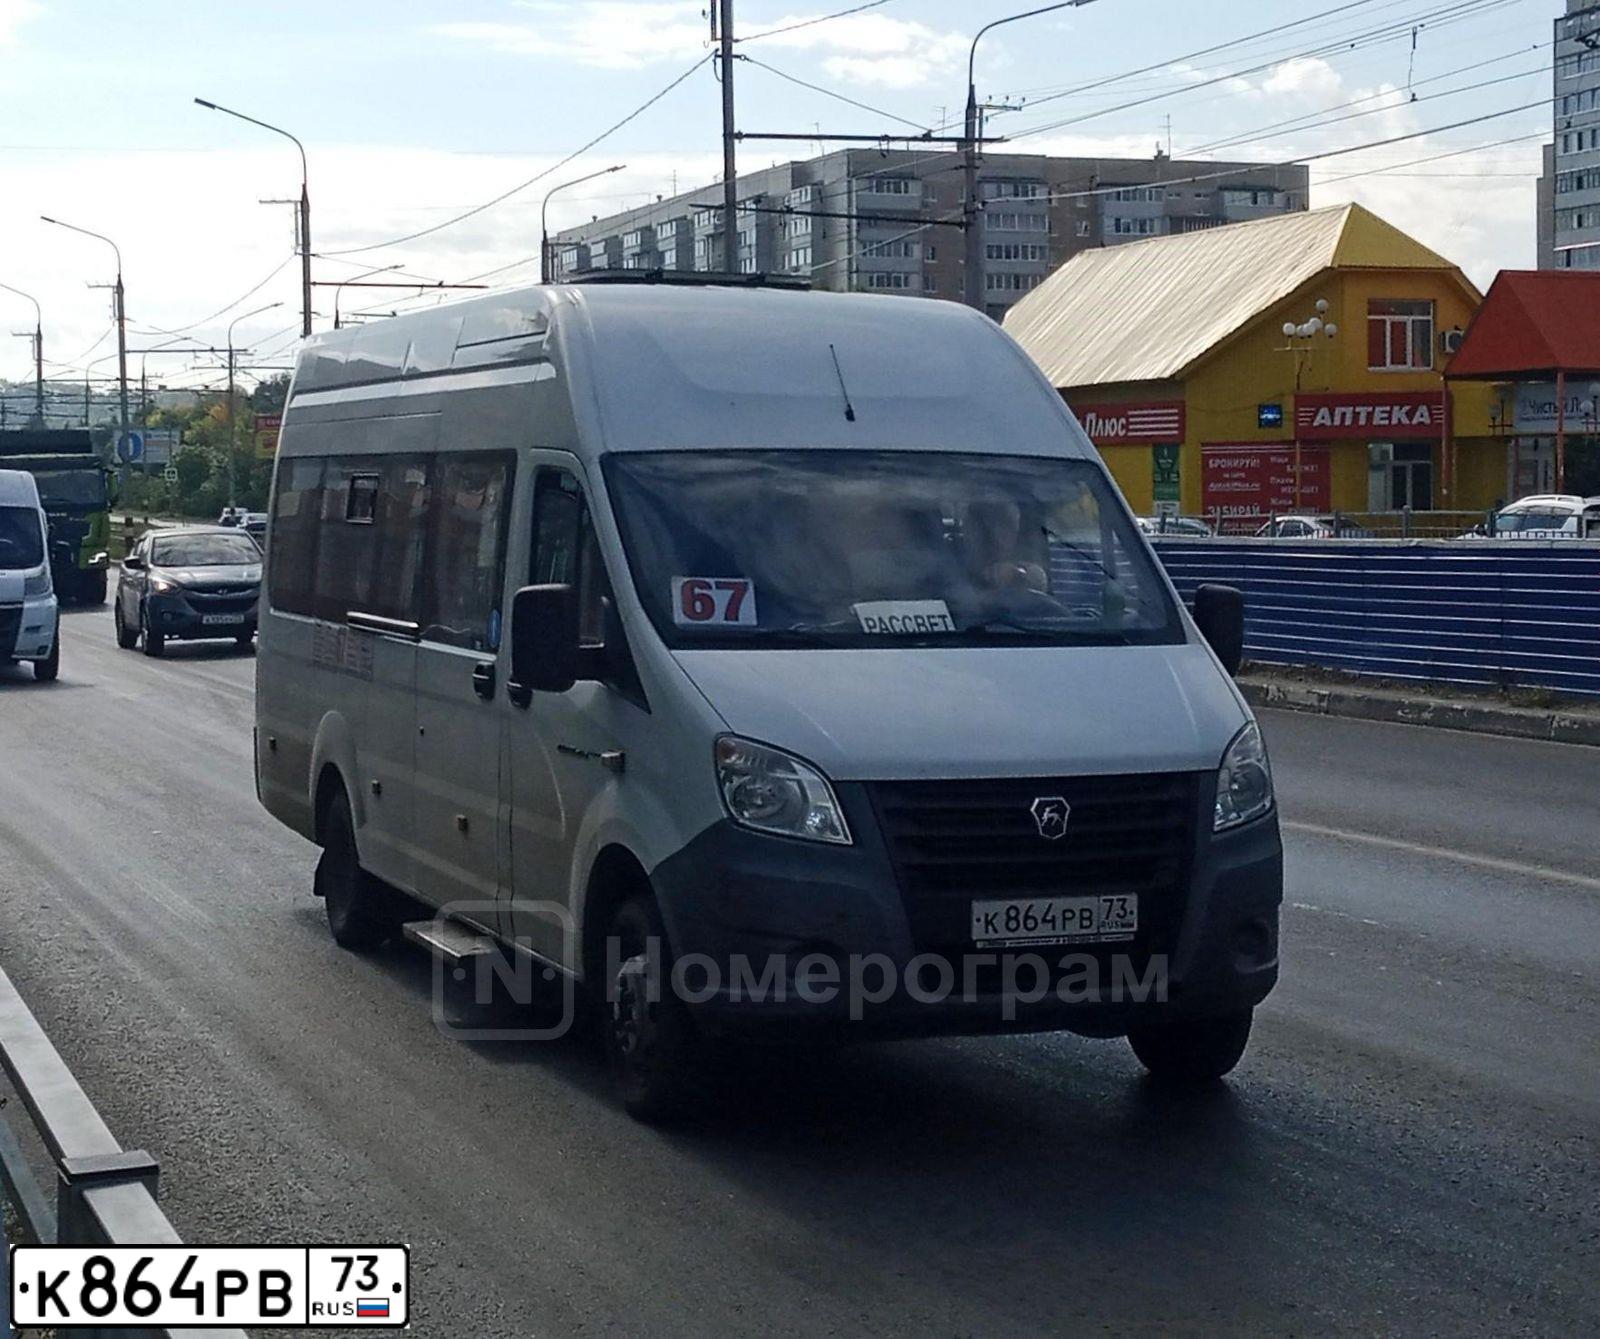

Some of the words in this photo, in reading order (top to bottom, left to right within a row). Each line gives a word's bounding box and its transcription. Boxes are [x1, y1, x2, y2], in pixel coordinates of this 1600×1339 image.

[1313, 405, 1432, 427] АПТЕКА
[680, 579, 748, 622] 67
[864, 614, 950, 634] РАССВЕТ
[984, 902, 1094, 935] К864РВ
[1102, 897, 1129, 920] 73
